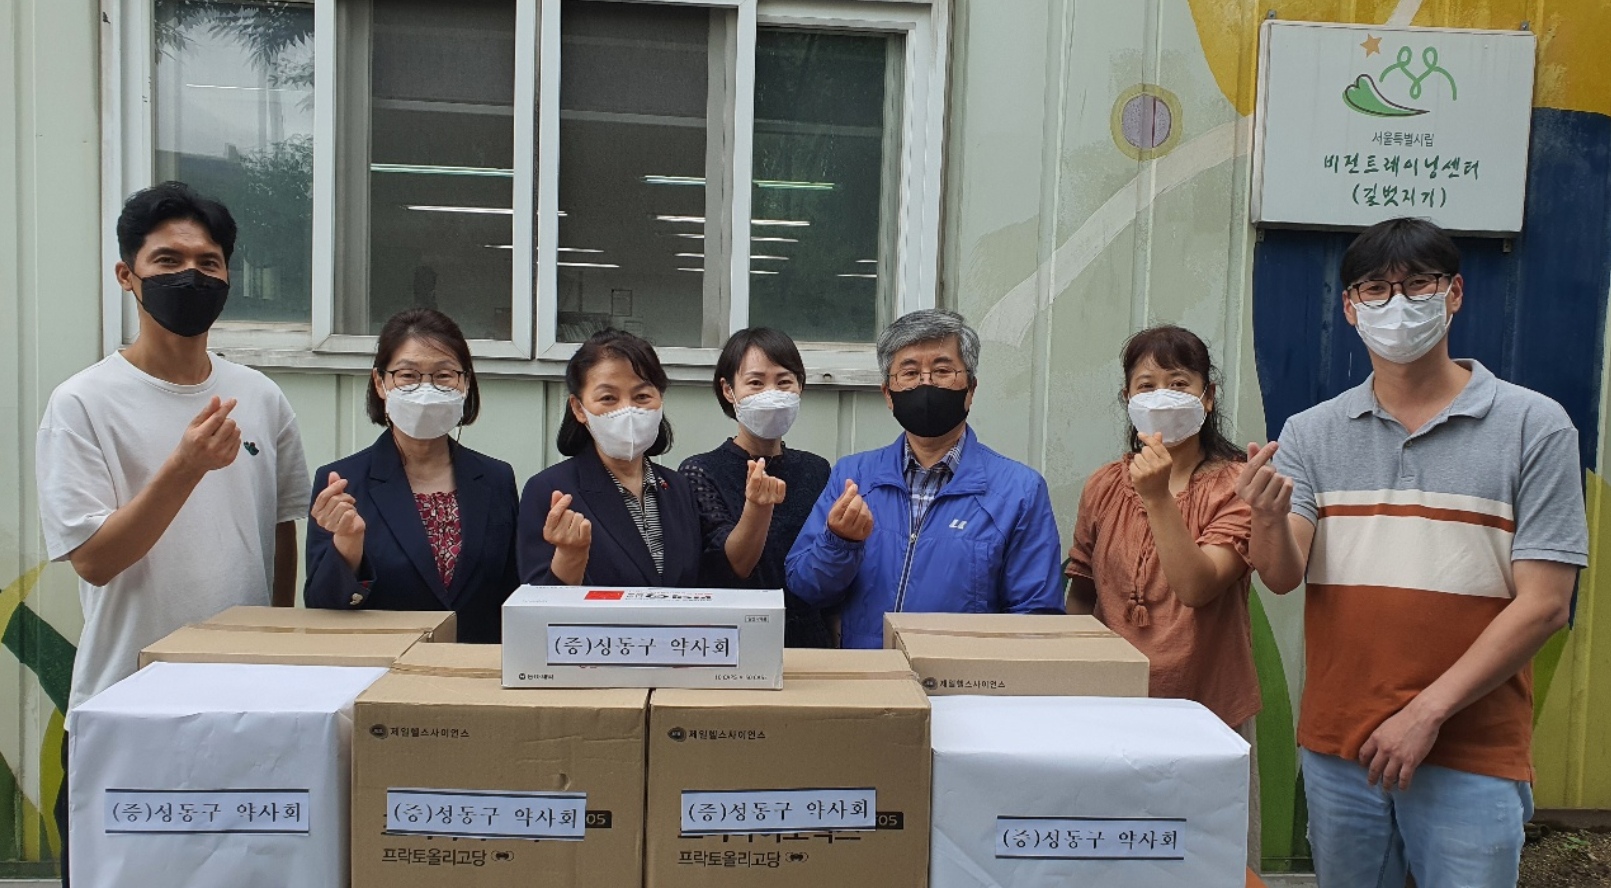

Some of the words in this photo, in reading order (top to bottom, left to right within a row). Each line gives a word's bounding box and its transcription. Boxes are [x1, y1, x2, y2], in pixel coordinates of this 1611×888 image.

[1371, 130, 1435, 148] 서울특별시립
[1324, 152, 1480, 180] 비전트레이닝센터
[1352, 183, 1447, 208] (길벗지기)
[670, 637, 730, 658] 약사회
[390, 727, 470, 739] 제일헬스사이언스
[112, 802, 222, 823] (증)성동구
[236, 802, 301, 823] 약사회
[394, 802, 500, 826] (증)성동구
[514, 807, 577, 829] 약사회
[688, 801, 793, 822] (증)성동구
[806, 798, 868, 821] 약사회
[1002, 828, 1105, 850] (증)성동구
[1118, 829, 1178, 850] 약사회
[381, 848, 488, 868] 프락토올리고당
[677, 850, 781, 868] 프락토올리고당
